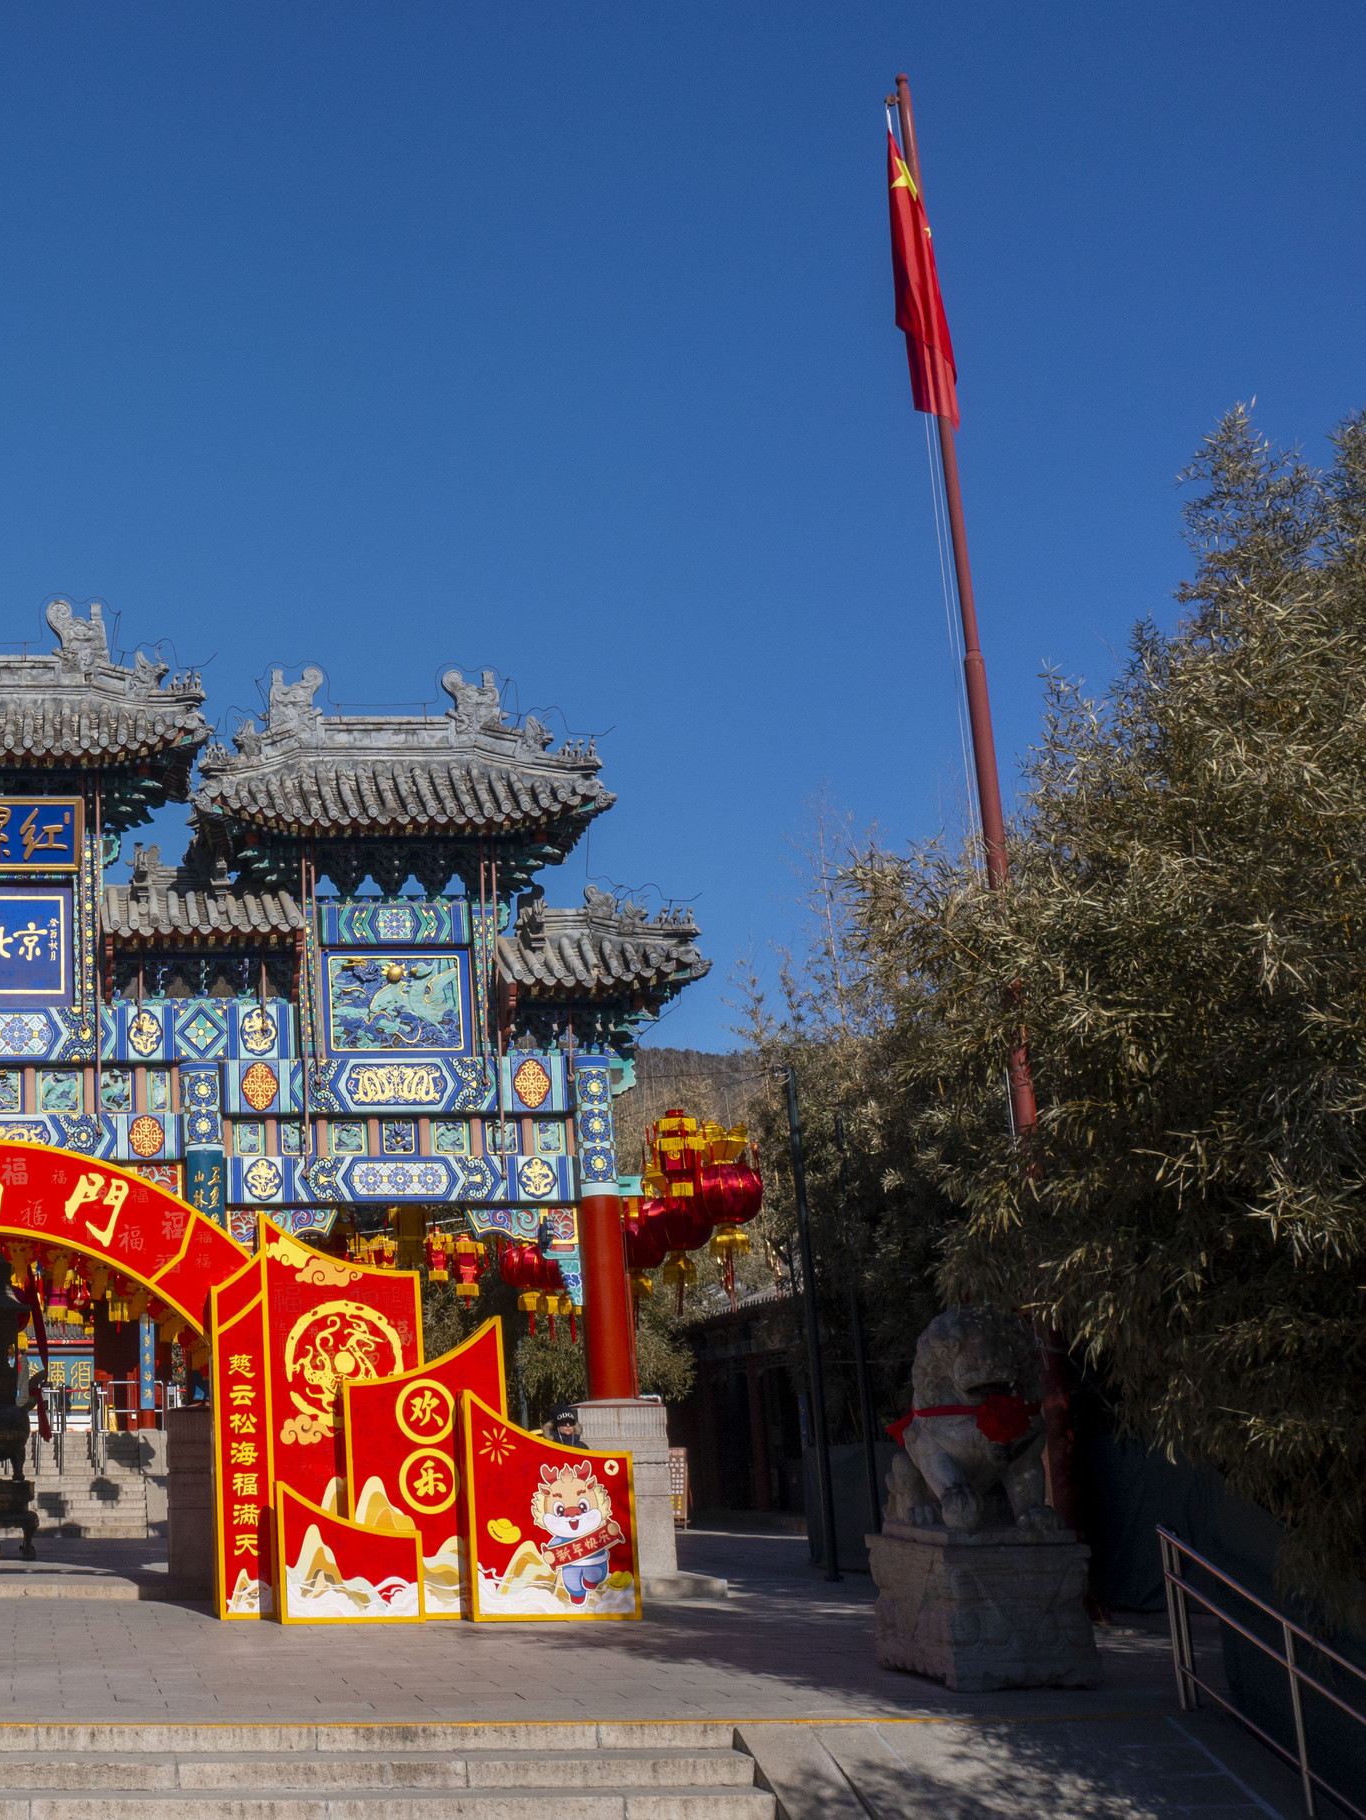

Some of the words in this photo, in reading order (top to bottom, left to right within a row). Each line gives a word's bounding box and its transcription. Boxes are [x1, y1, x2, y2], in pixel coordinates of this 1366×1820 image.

[228, 1353, 261, 1557] 慈云松海福满天
[410, 1391, 448, 1497] 欢乐
[556, 1529, 611, 1562] 新年快乐
